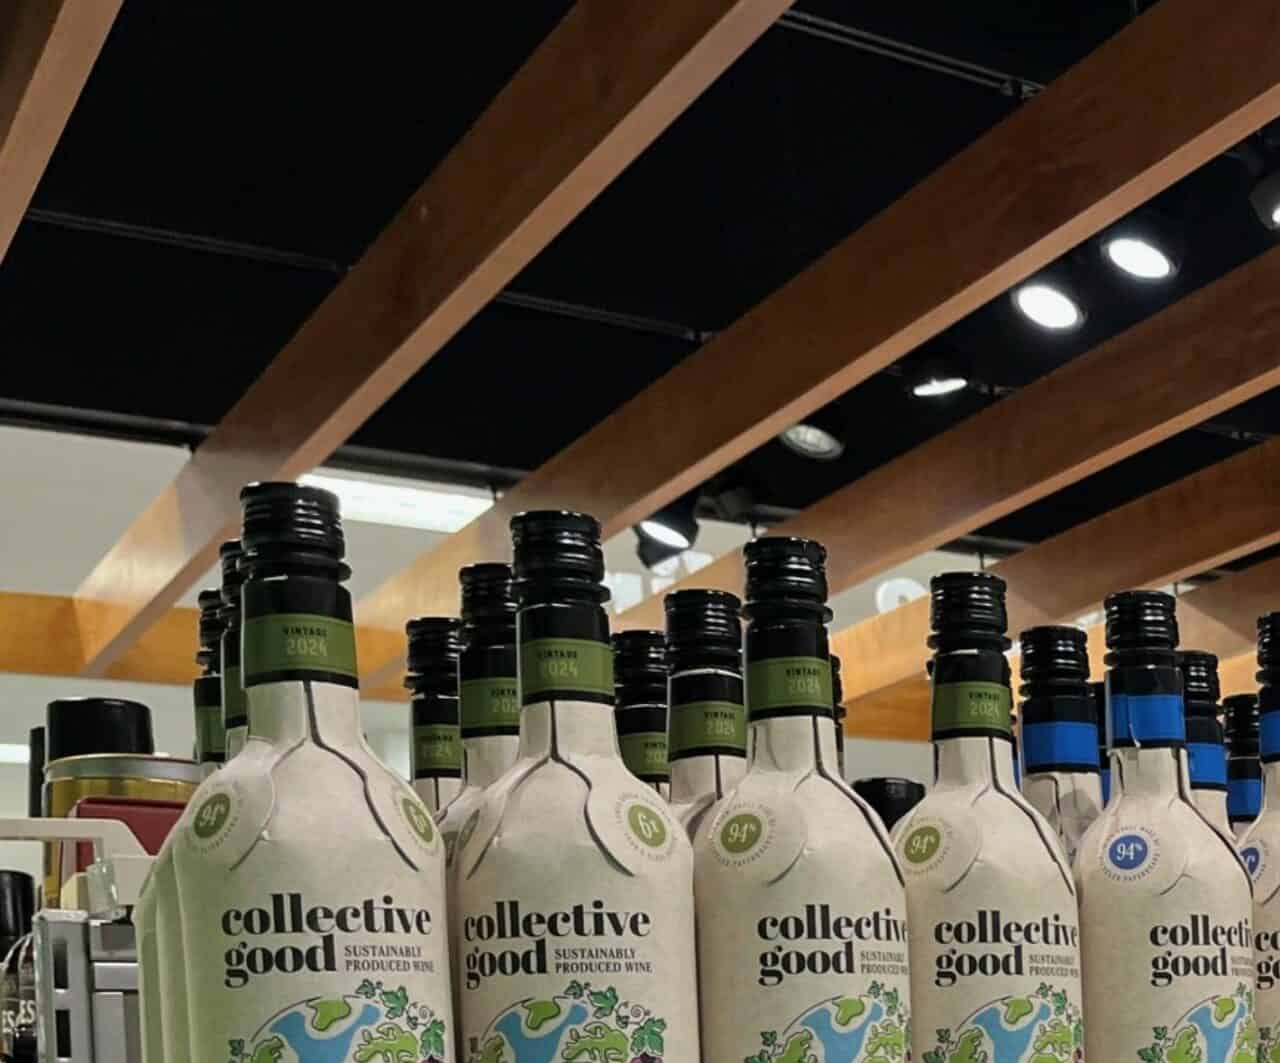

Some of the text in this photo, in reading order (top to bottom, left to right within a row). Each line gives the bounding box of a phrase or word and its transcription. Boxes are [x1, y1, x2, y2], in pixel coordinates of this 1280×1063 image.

[285, 638, 328, 656] 2024
[222, 893, 432, 936] collective
[464, 900, 650, 942] collective
[935, 910, 1077, 947] collective
[1150, 914, 1251, 947] collecti
[224, 934, 336, 989] good
[344, 945, 422, 958] SUSTAINABLY
[345, 959, 410, 972] PRODUCED
[466, 939, 547, 990] good
[555, 948, 636, 960] SUSTAINABLY
[555, 961, 652, 974] PRODUCED WINE
[758, 941, 854, 986] good
[935, 944, 1024, 987] good
[1151, 947, 1228, 988] good
